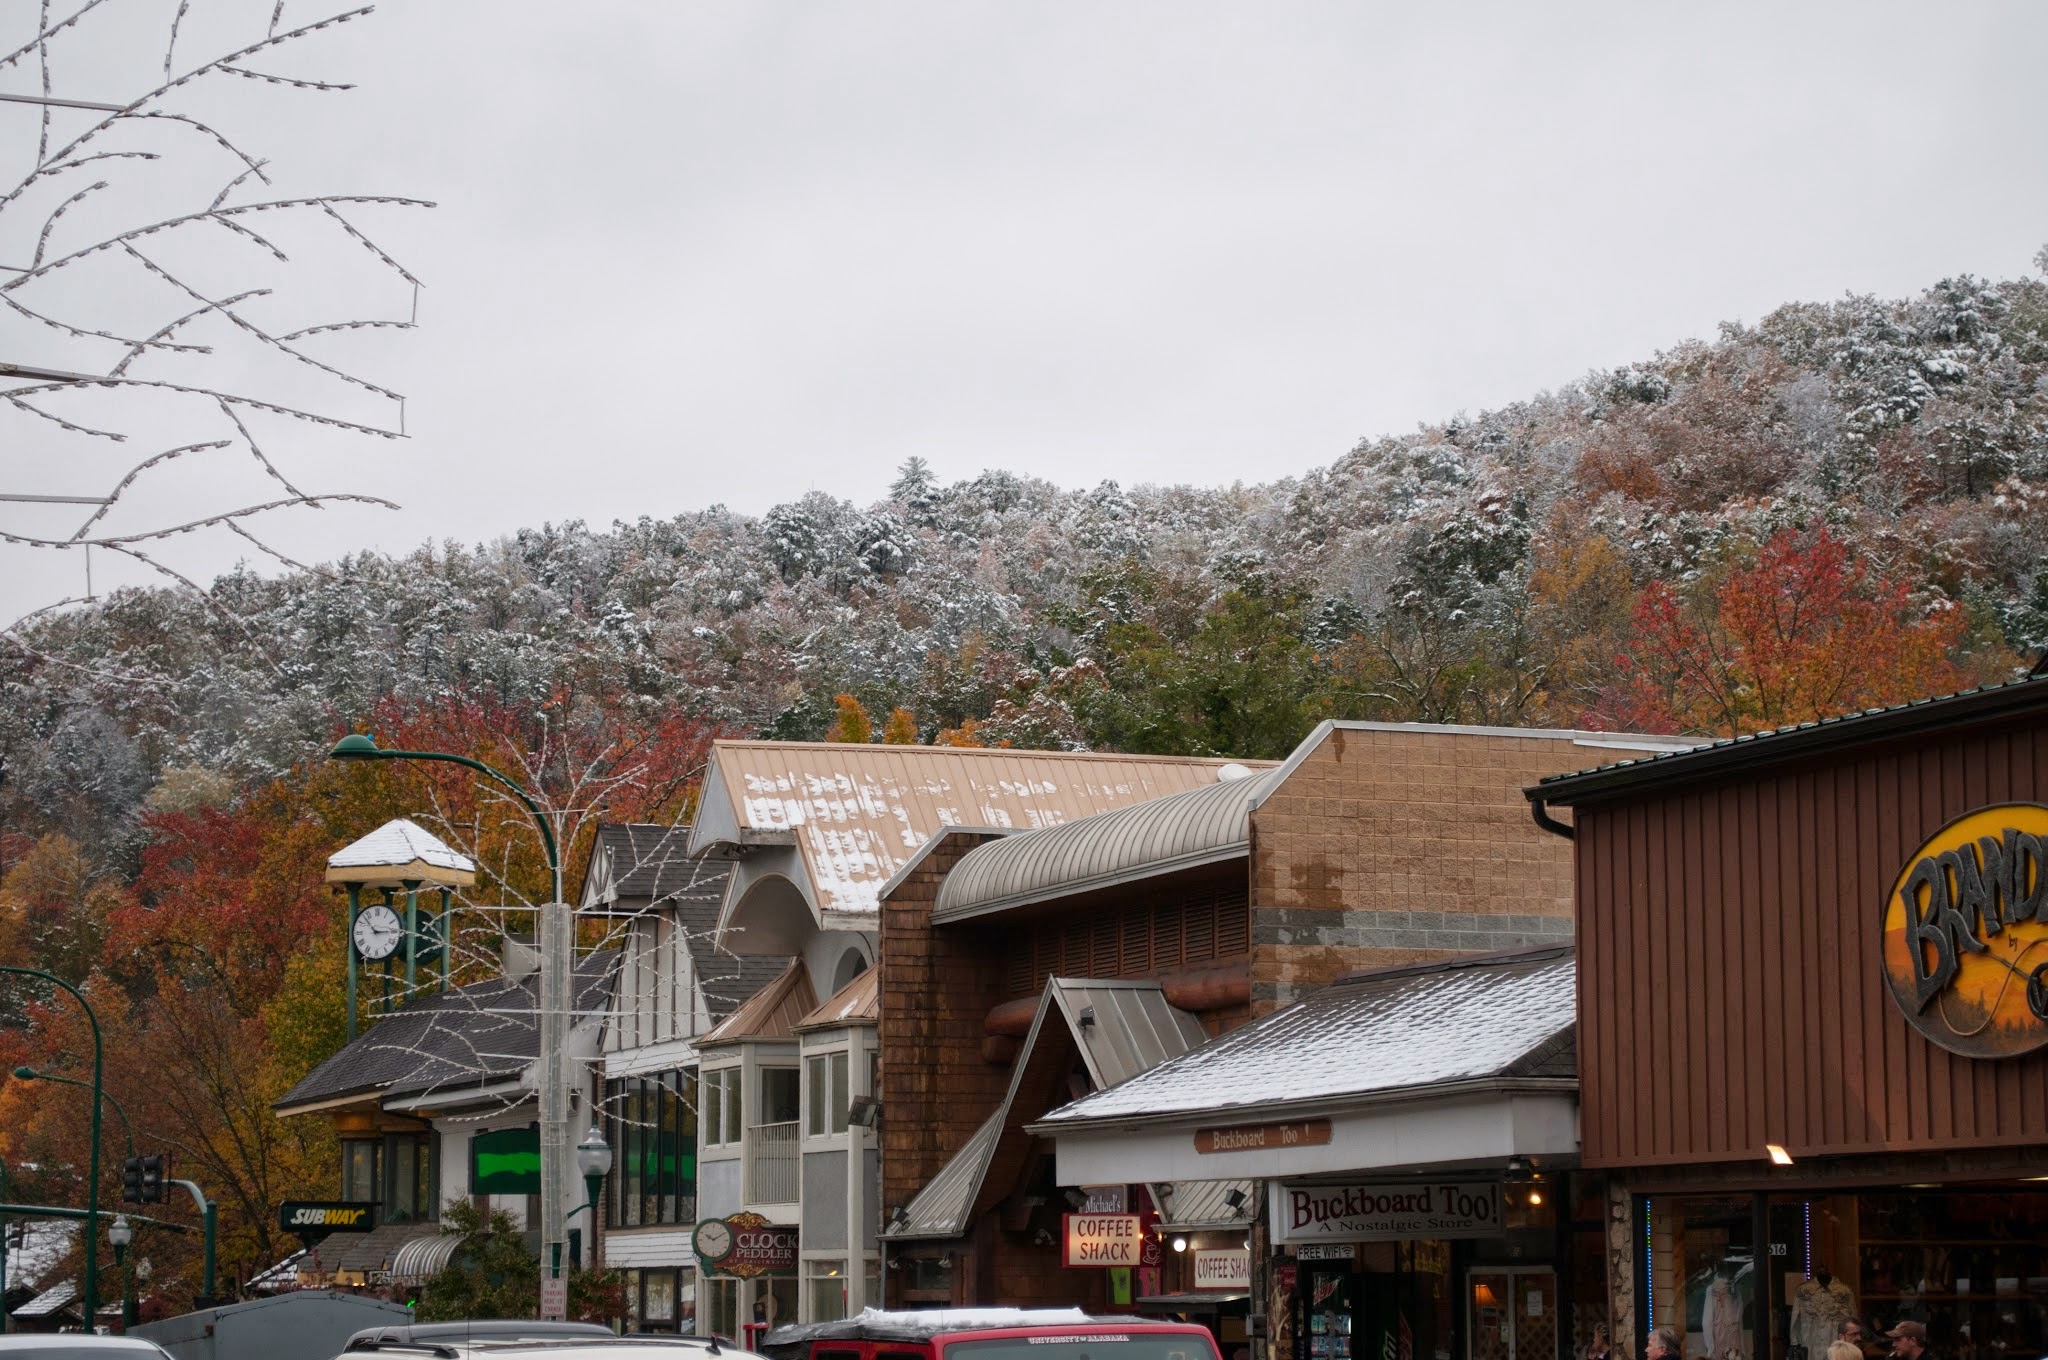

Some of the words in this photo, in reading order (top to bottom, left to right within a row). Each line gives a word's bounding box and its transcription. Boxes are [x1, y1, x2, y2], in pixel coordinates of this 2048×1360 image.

[1900, 828, 2048, 1016] BRAND
[2008, 934, 2018, 952] by
[1213, 1128, 1265, 1149] Buckboard
[1085, 1194, 1121, 1213] Michael's
[1290, 1186, 1433, 1230] Buckboard
[1440, 1184, 1498, 1224] Too!
[290, 1208, 366, 1225] SUBWAY
[1318, 1222, 1332, 1232] A
[1339, 1219, 1421, 1233] Nostalgic
[1427, 1217, 1473, 1229] Store
[1077, 1219, 1133, 1237] COFFEE
[736, 1233, 799, 1248] CLOCK
[736, 1248, 792, 1259] PEDDLER
[1080, 1242, 1130, 1260] SHACK
[1298, 1246, 1321, 1259] FREE
[1322, 1246, 1341, 1258] WIFI
[1198, 1257, 1228, 1279] COFFEE
[1028, 1335, 1080, 1344] UNIVERSITY
[1087, 1335, 1130, 1343] ALABAMA
